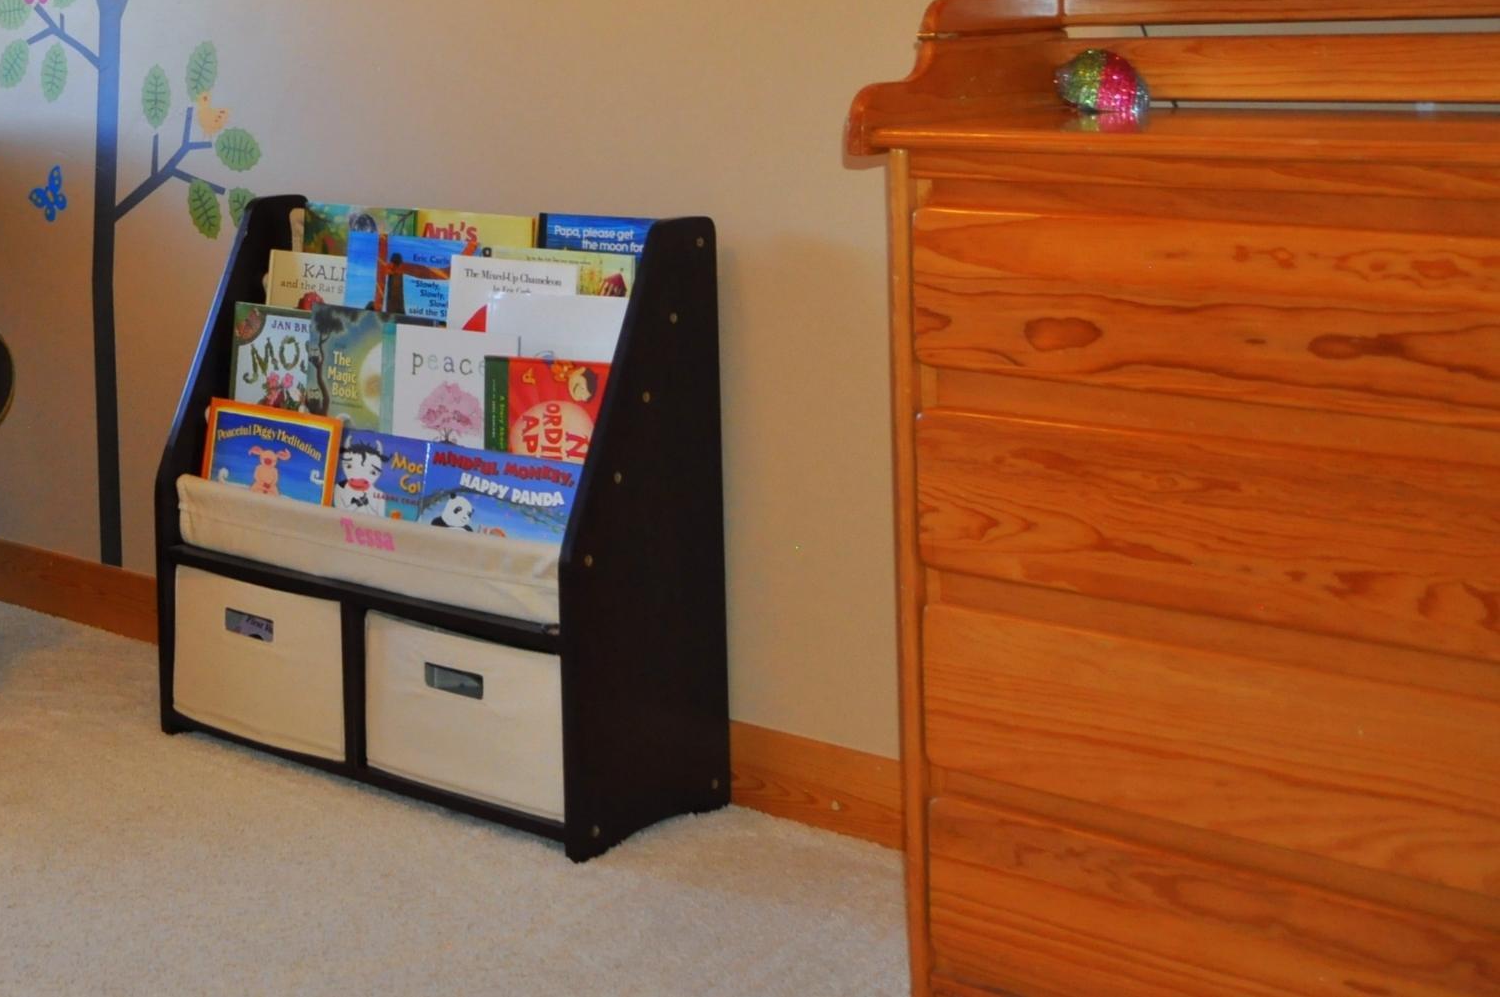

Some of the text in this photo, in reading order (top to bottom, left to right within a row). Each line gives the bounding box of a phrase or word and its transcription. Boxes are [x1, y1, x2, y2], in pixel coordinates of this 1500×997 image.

[422, 221, 478, 242] Anh's
[553, 224, 635, 242] Papa, please get
[582, 239, 599, 251] the
[600, 242, 629, 252] moon
[280, 279, 299, 290] and
[301, 281, 316, 291] the
[465, 268, 480, 279] The
[520, 274, 563, 288] Chameleon
[408, 306, 424, 315] said
[425, 308, 438, 316] the
[270, 319, 291, 330] JAN
[332, 350, 352, 366] The
[327, 366, 357, 386] Magic
[331, 383, 358, 400] Book
[217, 423, 322, 461] Peaceful Piggy Meditation
[432, 451, 499, 476] MINDFUL
[459, 472, 565, 506] HAPPY PANDA
[339, 516, 396, 552] Tessa
